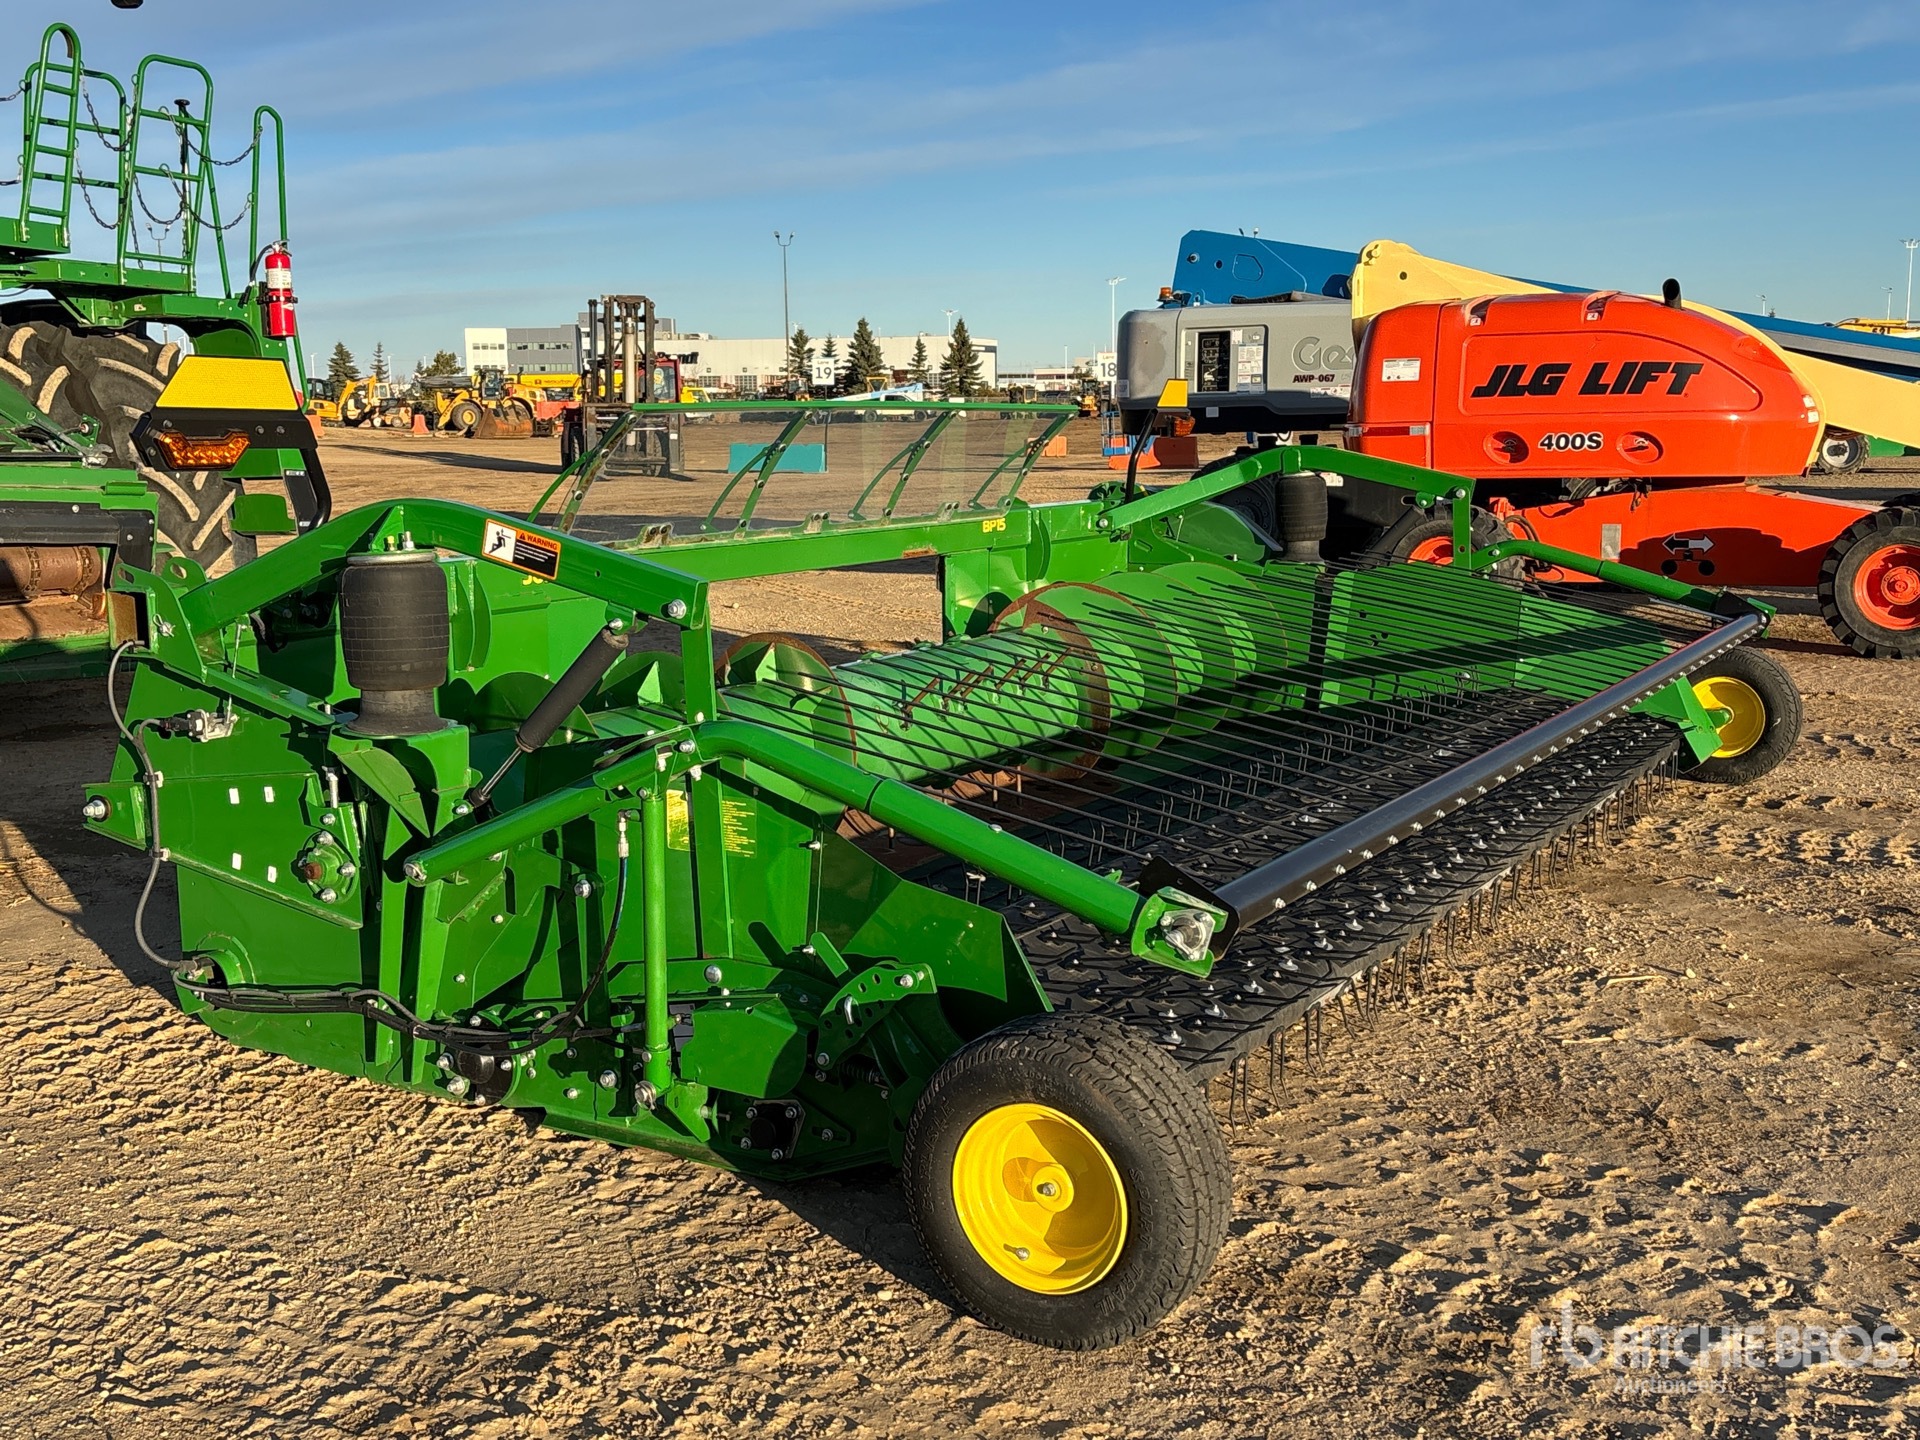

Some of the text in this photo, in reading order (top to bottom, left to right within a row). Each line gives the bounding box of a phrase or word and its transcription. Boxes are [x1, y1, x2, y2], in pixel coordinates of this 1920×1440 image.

[815, 366, 832, 379] 19
[1100, 362, 1117, 377] 18
[1292, 373, 1335, 384] AWP-067
[1470, 361, 1704, 398] JLG LIFT
[1538, 432, 1604, 452] 400S
[982, 517, 1007, 533] BP15
[526, 534, 558, 551] WARNING
[919, 1100, 956, 1214] CARLISLE
[1094, 1167, 1153, 1316] SPORT TRAIL
